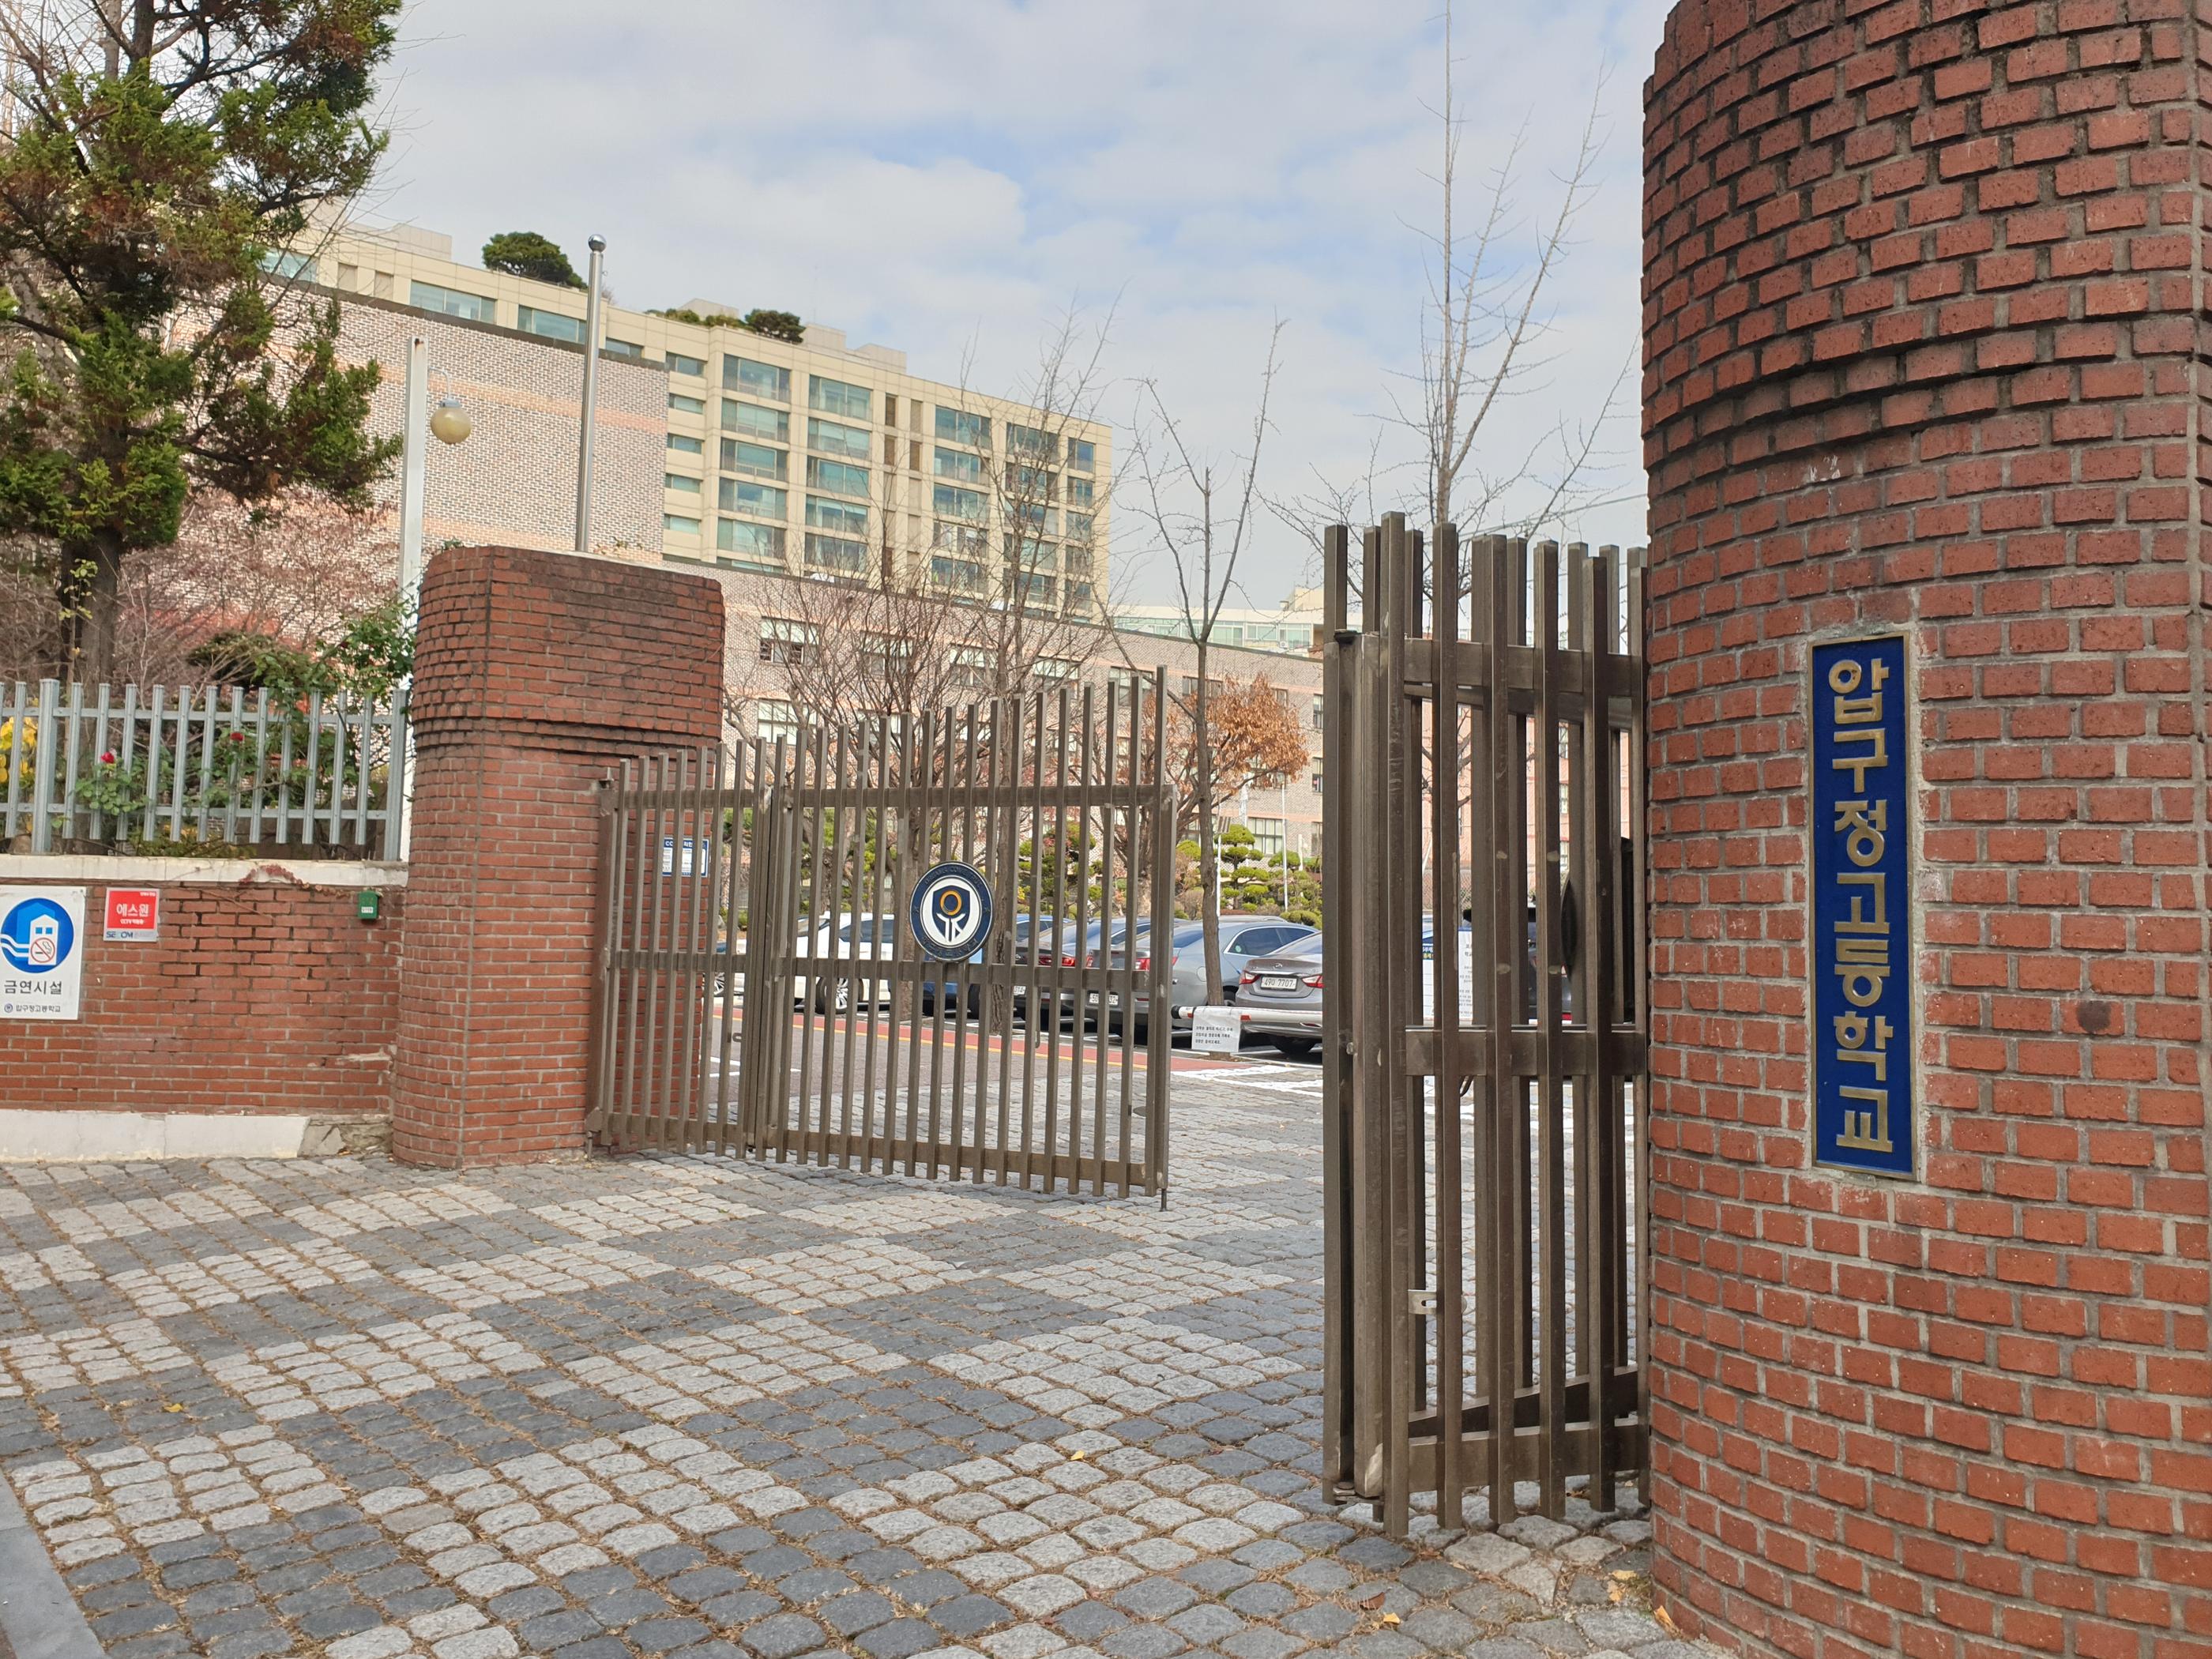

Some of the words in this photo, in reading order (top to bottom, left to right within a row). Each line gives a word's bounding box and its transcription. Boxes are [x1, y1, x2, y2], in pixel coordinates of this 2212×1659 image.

[116, 903, 149, 918] 에스원
[1827, 659, 1894, 1153] 압구정고등학교
[4, 980, 62, 995] 금연시설
